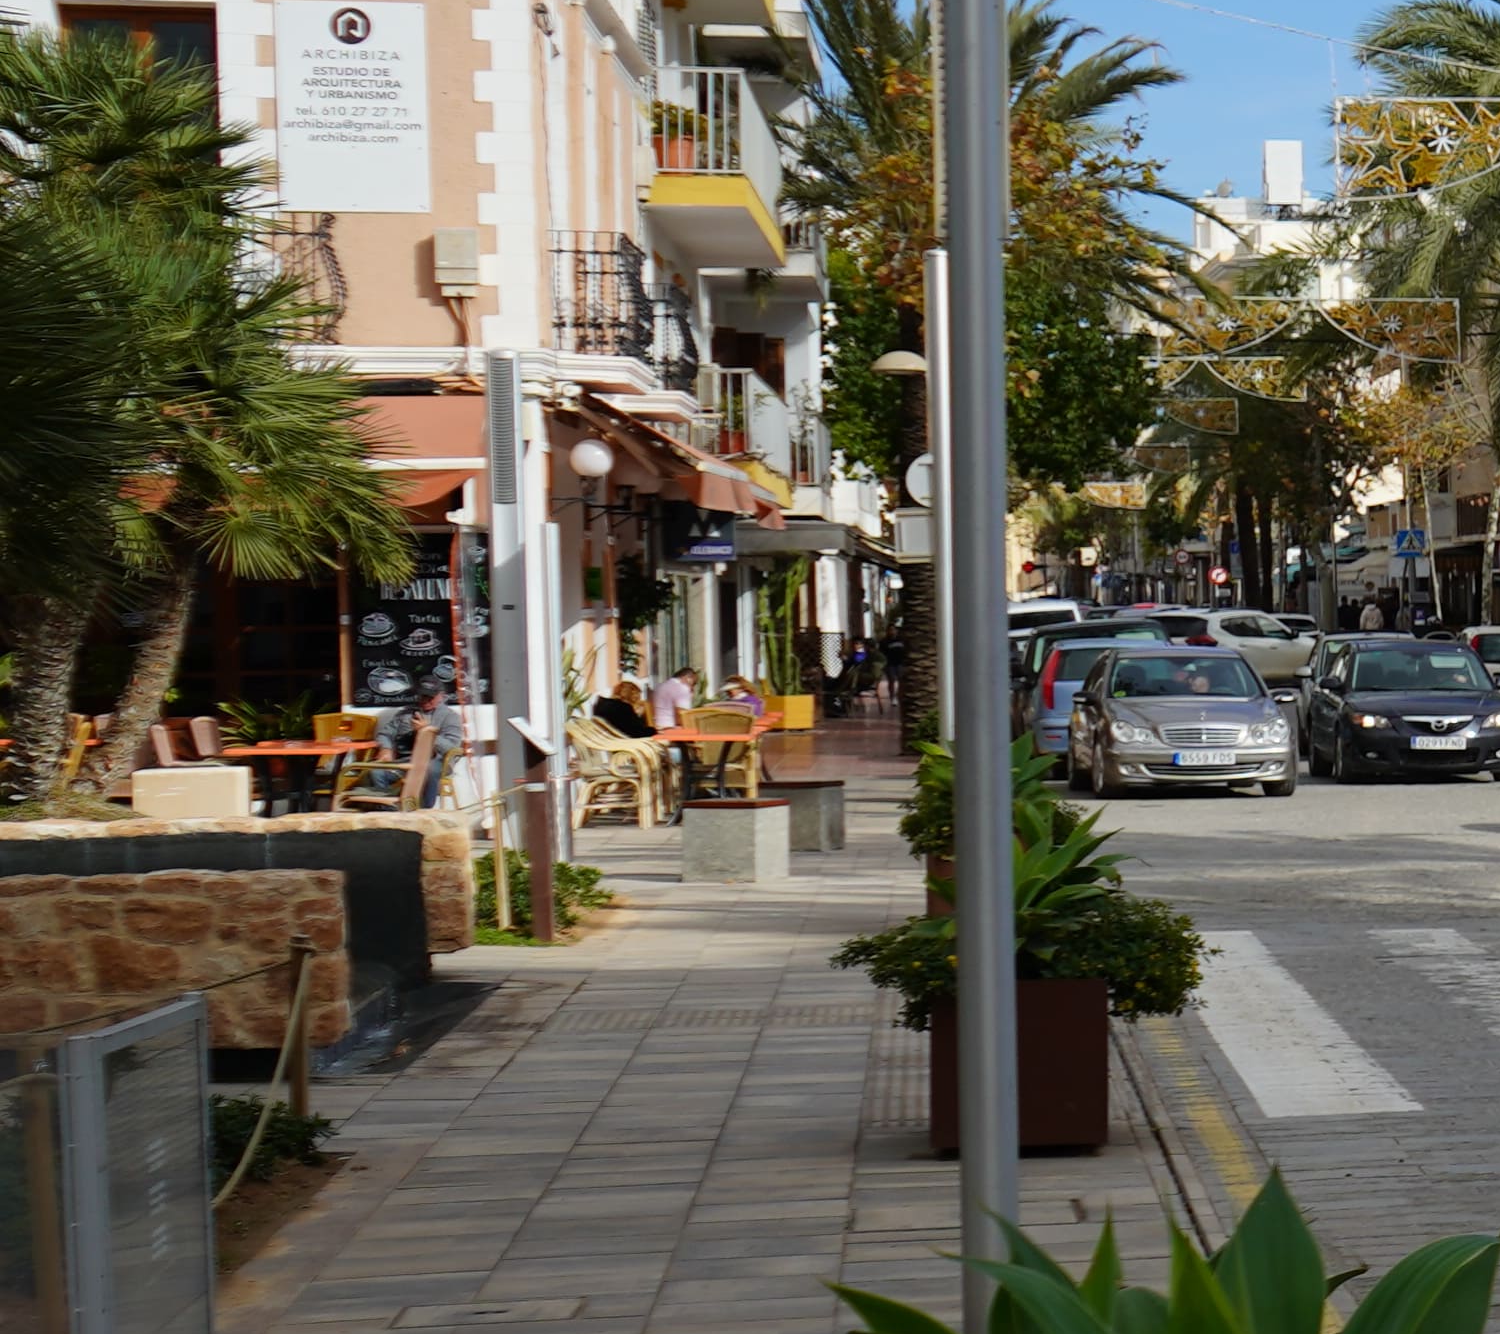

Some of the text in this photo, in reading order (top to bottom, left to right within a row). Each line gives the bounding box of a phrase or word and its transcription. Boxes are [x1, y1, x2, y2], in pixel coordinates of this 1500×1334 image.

[302, 49, 401, 61] ARCHIBIZA
[312, 67, 391, 77] ESTUDIO DE
[302, 78, 402, 89] ARQUITECTURA
[306, 90, 398, 100] Y URBANISMO
[321, 106, 346, 117] 610
[351, 107, 367, 117] 27
[372, 107, 388, 117] 27
[393, 107, 408, 117] 71
[283, 119, 422, 132] archibiza@gmail.com
[307, 133, 399, 144] archibiza.com
